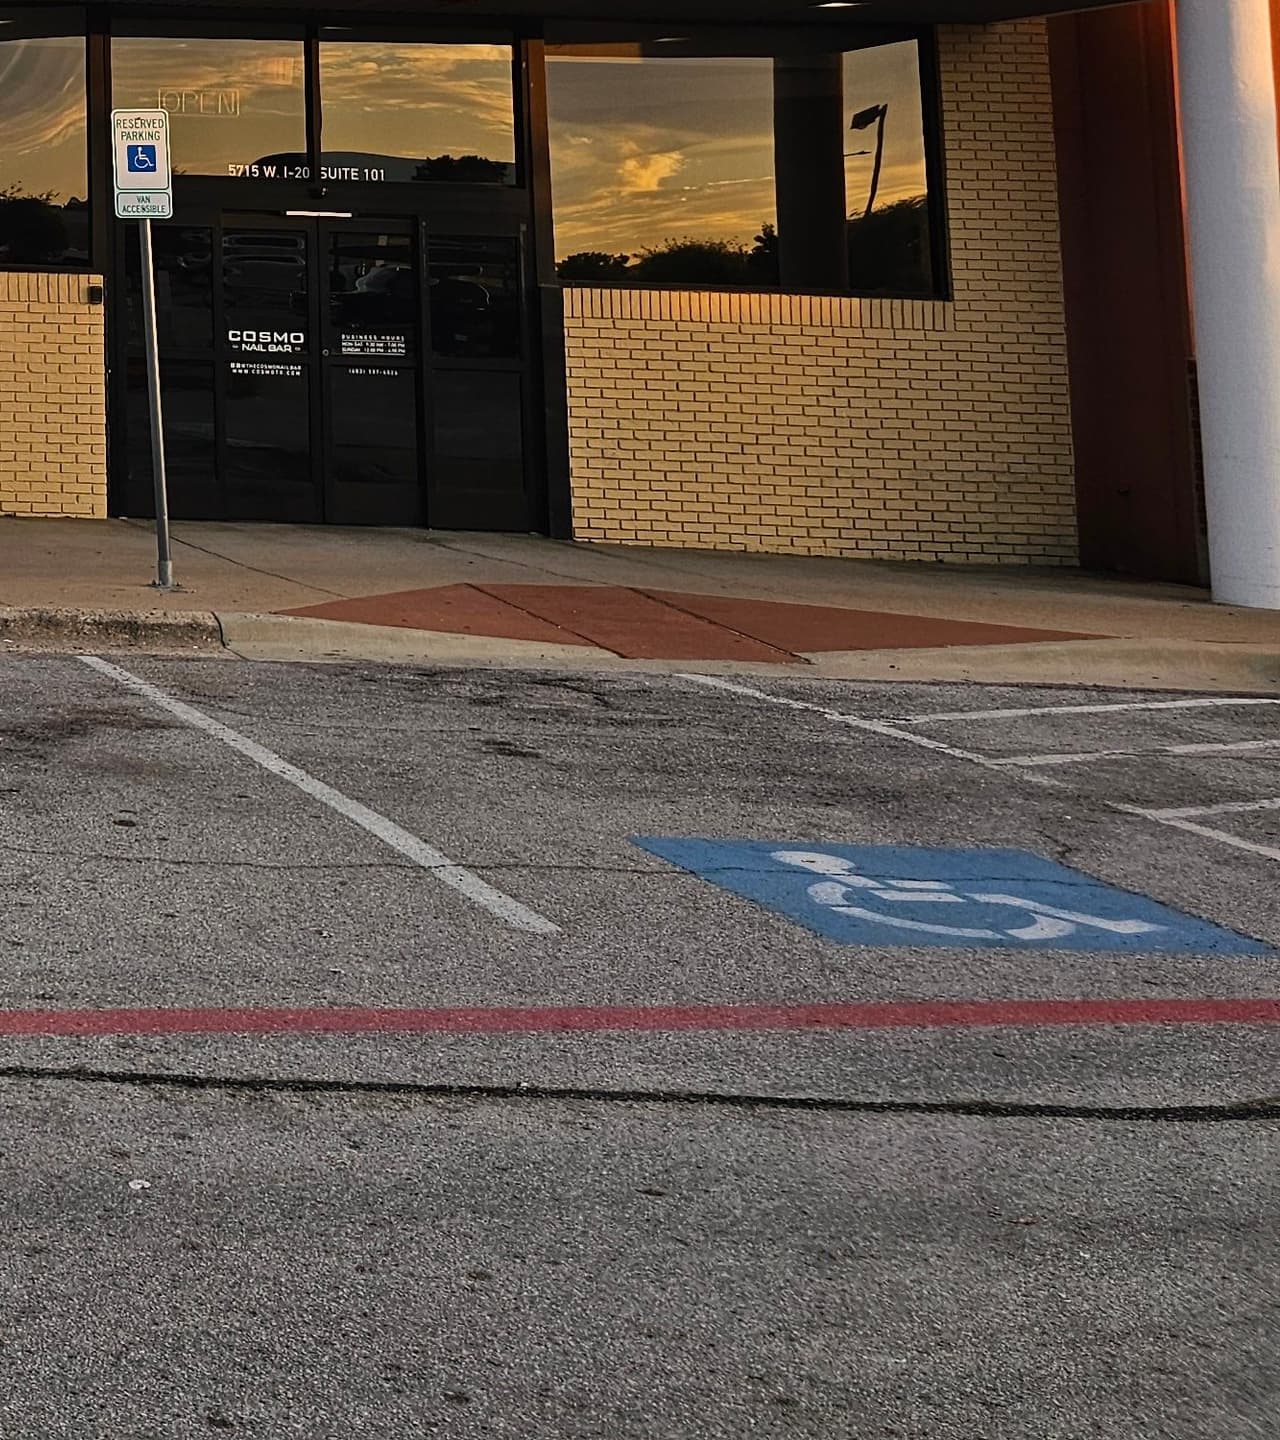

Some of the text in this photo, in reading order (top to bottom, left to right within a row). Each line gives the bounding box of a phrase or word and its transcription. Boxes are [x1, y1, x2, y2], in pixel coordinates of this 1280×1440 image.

[162, 91, 236, 114] OPEN
[116, 118, 165, 129] RESERVED
[120, 130, 161, 141] PARKING
[228, 164, 385, 182] 5715 W. I-20 SUITE 101
[136, 195, 151, 204] VAN
[121, 204, 167, 214] ACCESSIBLE
[228, 330, 304, 343] COSMO
[241, 343, 267, 352] NAIL
